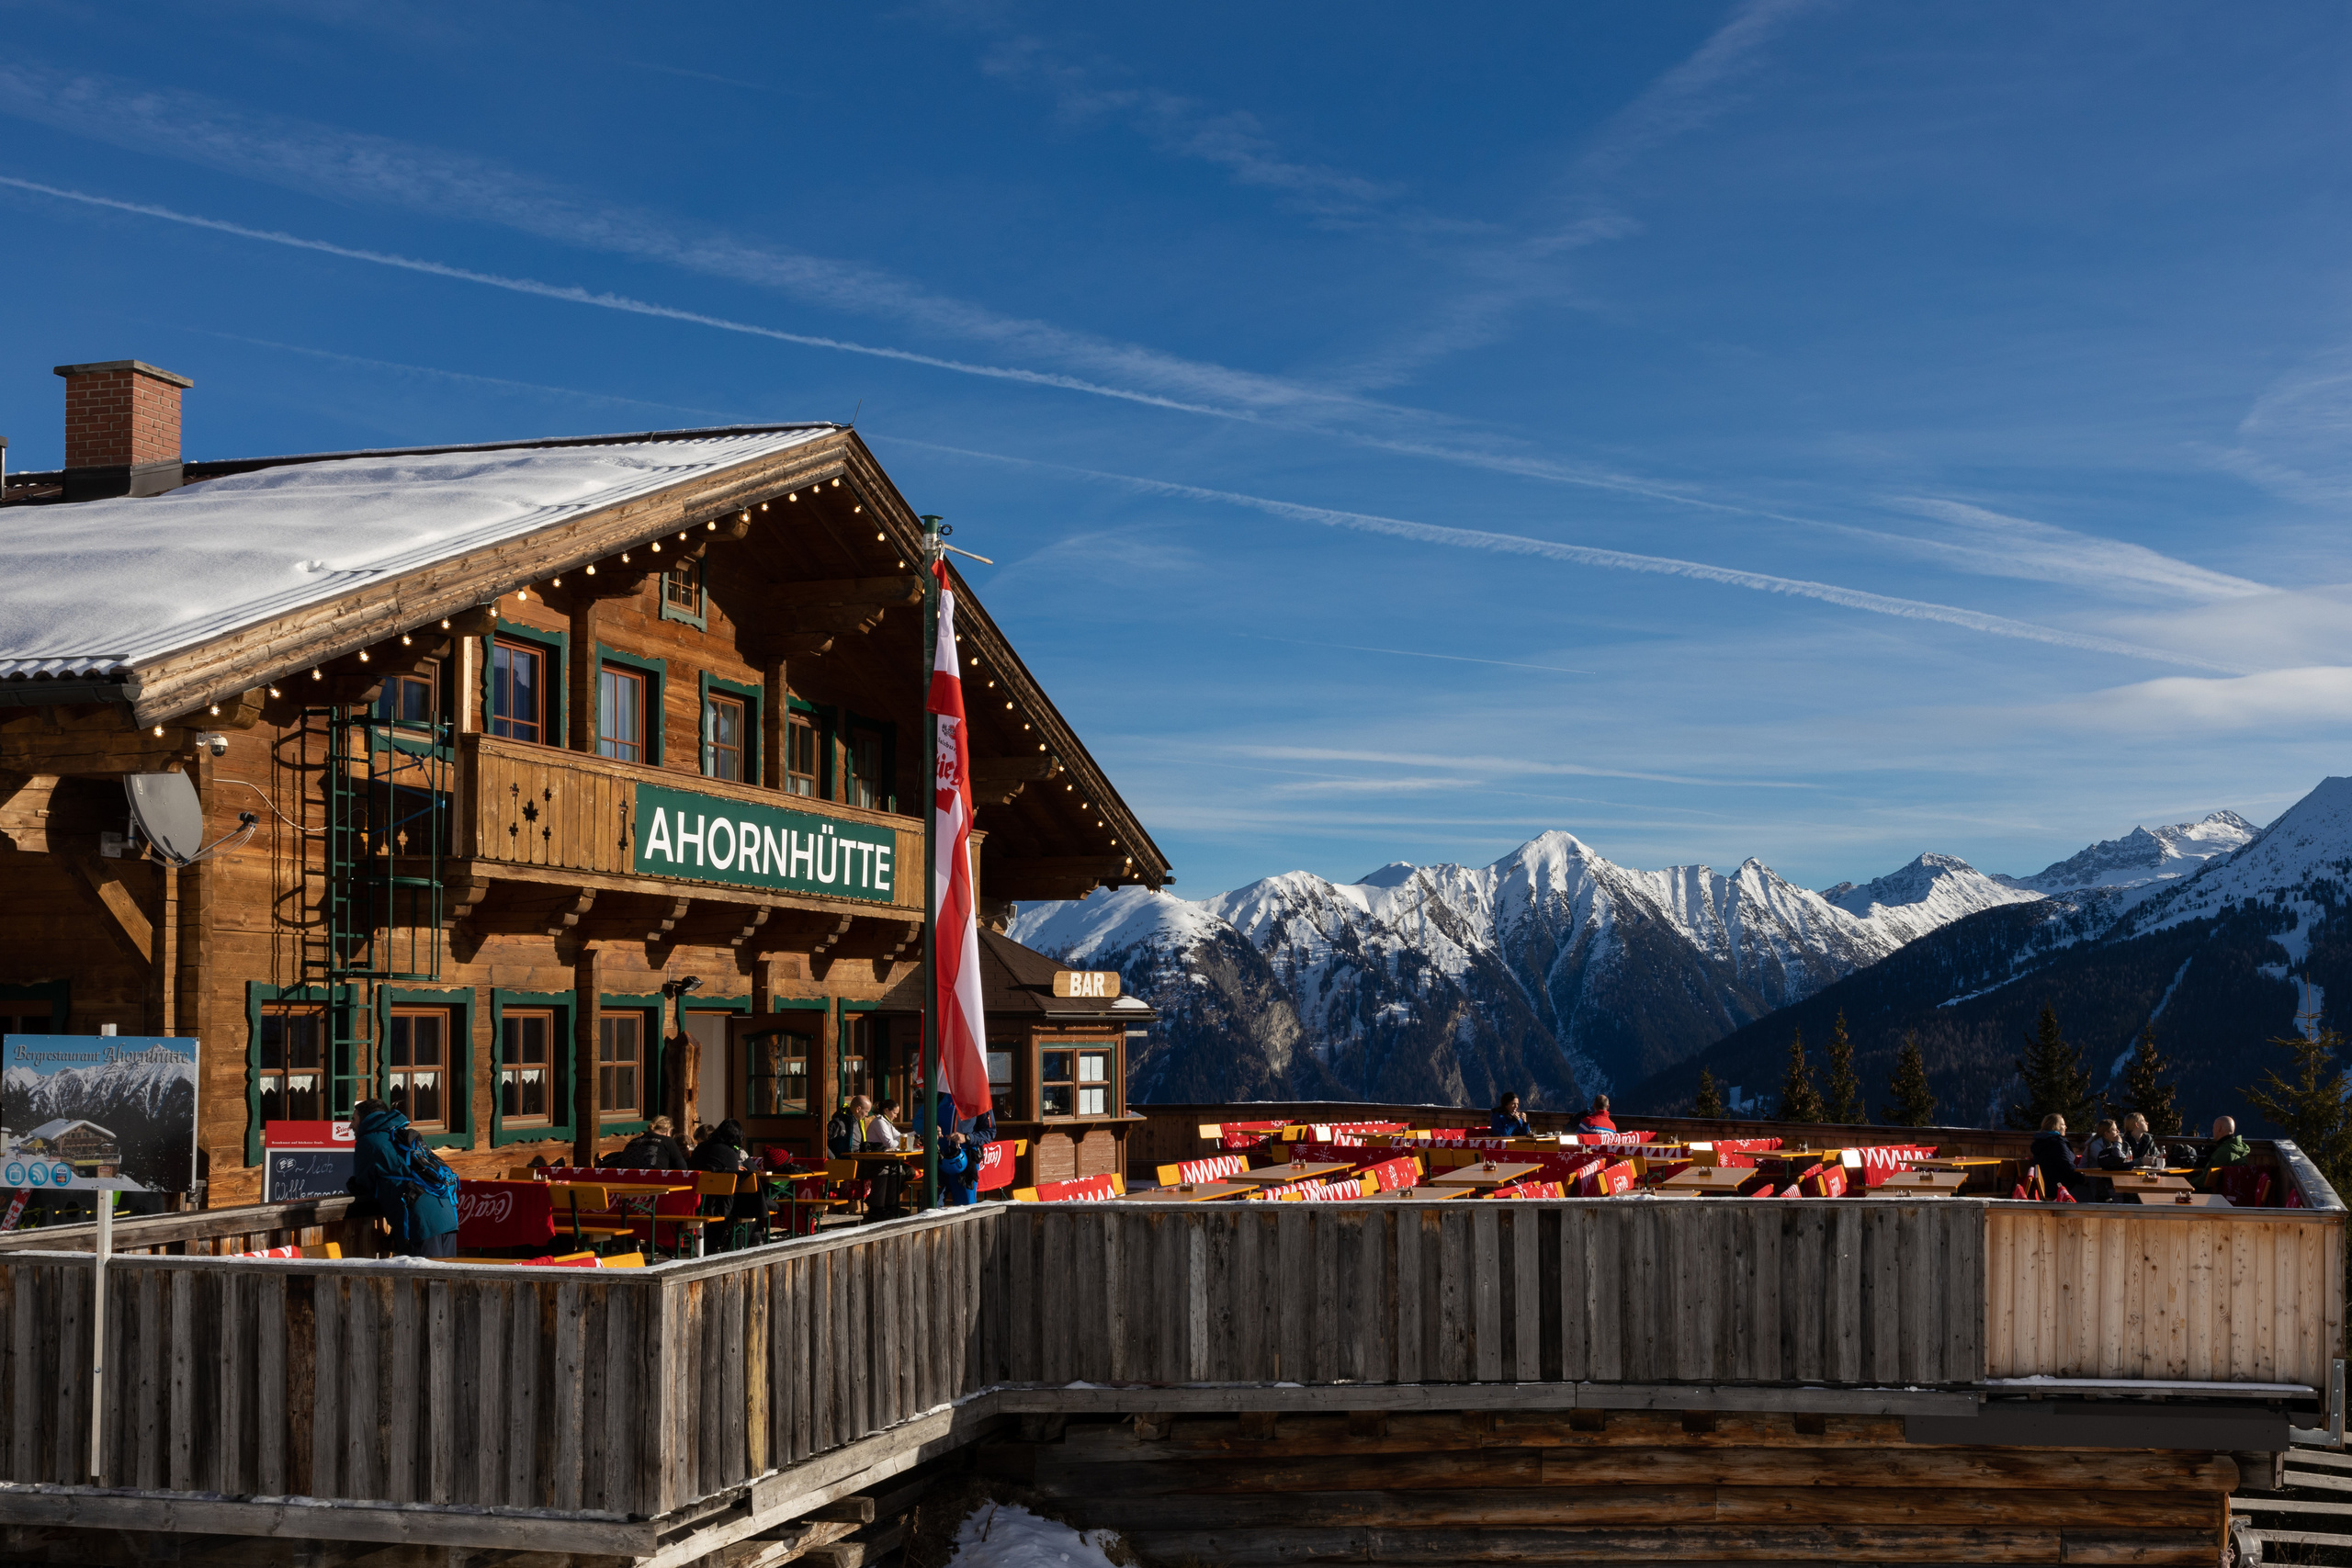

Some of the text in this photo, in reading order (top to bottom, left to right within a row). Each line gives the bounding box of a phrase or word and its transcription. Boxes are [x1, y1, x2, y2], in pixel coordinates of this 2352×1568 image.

[644, 807, 891, 891] AHORNHÜTTE
[1069, 972, 1105, 997] BAR
[13, 1043, 189, 1066] Bergrestaurant Ahornhütte
[335, 1125, 352, 1134] Stieg
[457, 1190, 513, 1225] Coca-Co
